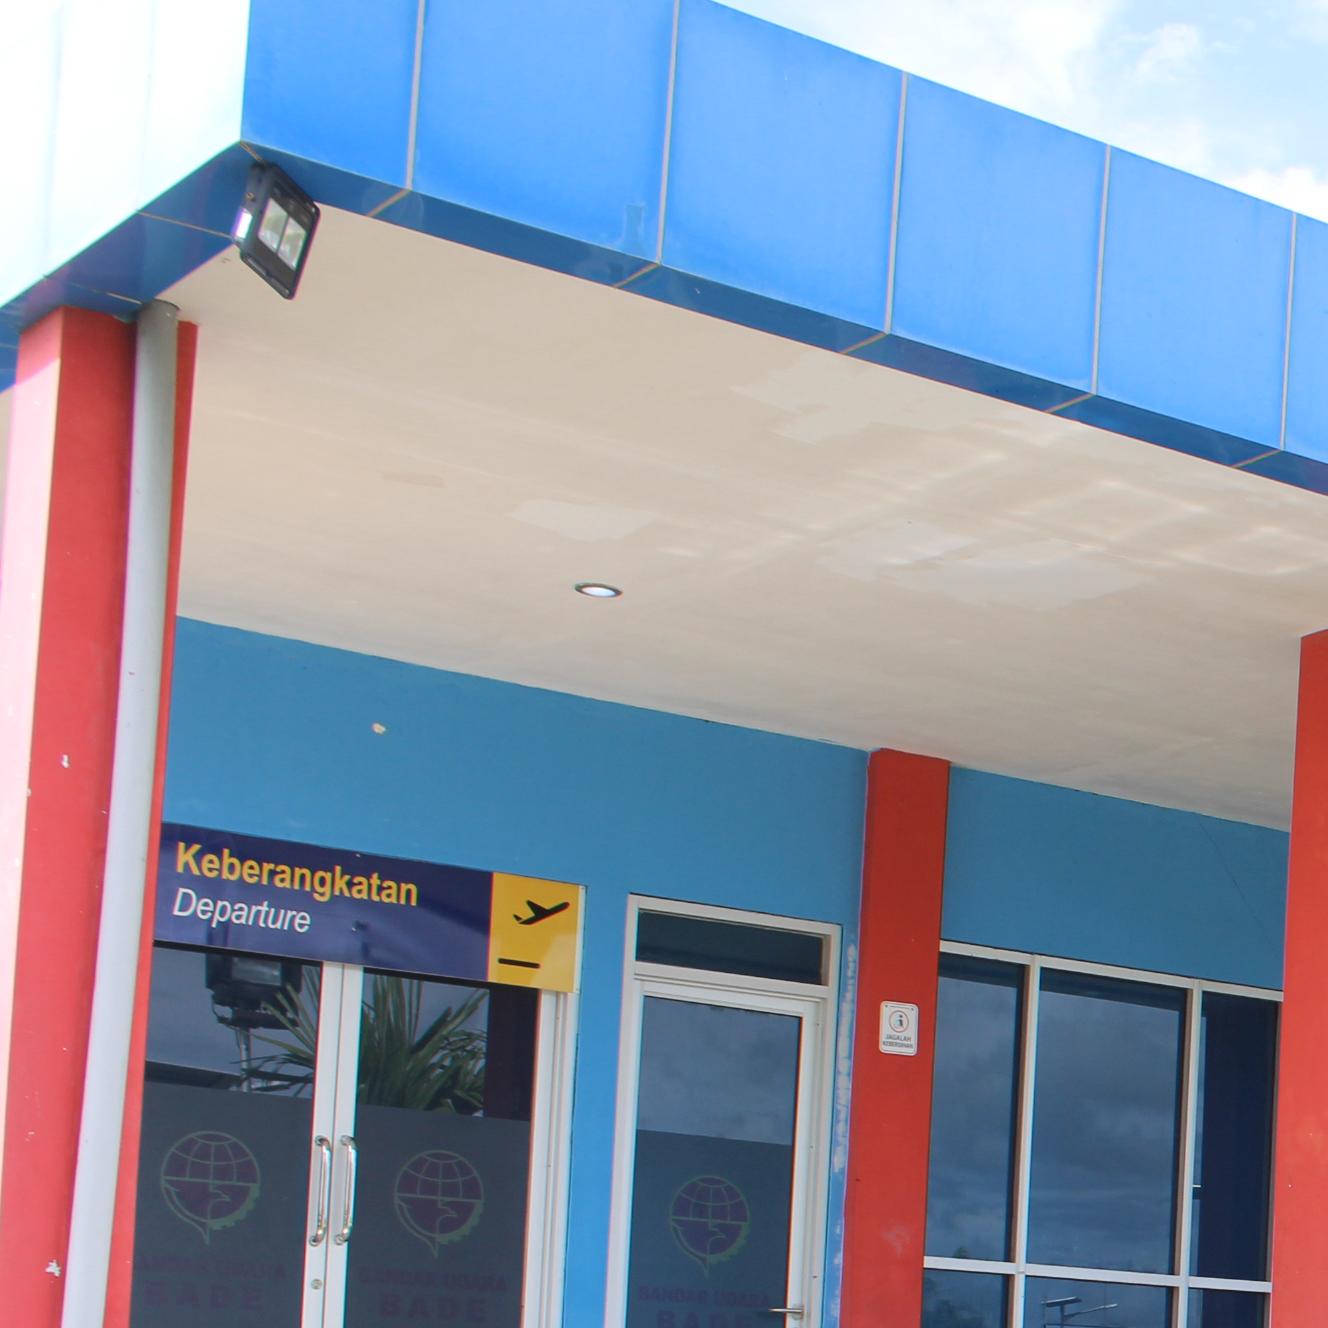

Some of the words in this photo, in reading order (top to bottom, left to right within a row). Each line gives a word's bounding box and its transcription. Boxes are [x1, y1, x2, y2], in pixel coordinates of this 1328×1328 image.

[176, 841, 418, 906] Keberangkatan
[172, 887, 312, 933] Departure
[360, 1265, 436, 1286] BANDAR
[443, 1272, 508, 1292] UDARA
[144, 1280, 264, 1311] BADE
[378, 1293, 488, 1323] BADE
[637, 1285, 708, 1306] BANDAR
[714, 1291, 771, 1309] UDARA
